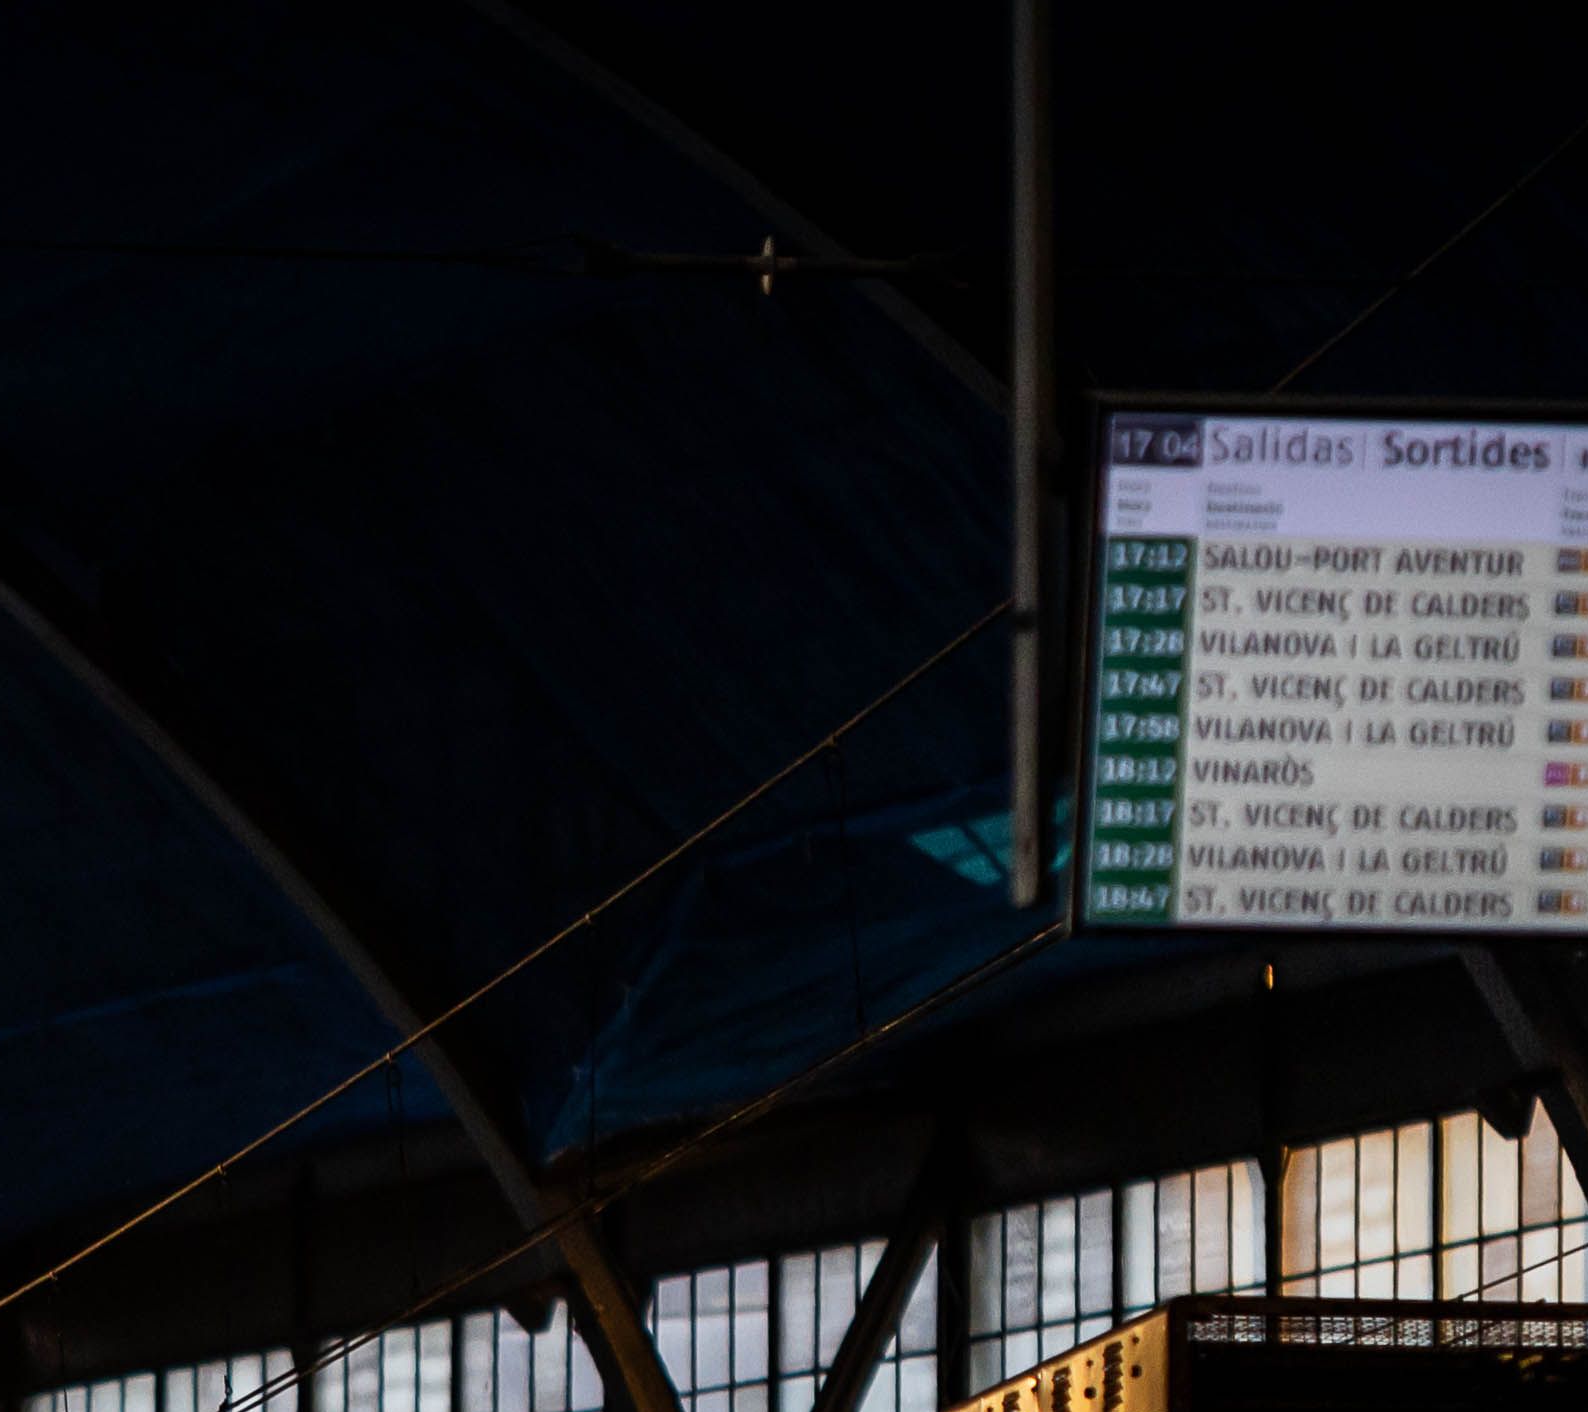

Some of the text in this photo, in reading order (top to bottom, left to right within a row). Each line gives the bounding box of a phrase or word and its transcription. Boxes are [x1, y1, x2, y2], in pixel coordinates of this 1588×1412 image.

[1211, 425, 1354, 465] Salidas
[1383, 429, 1551, 470] Sortides
[1205, 545, 1523, 576] SALOU-PORT AVENTUR
[1110, 585, 1186, 614] 17:17
[1203, 586, 1242, 614] ST.
[1257, 588, 1350, 621] VICENÇ
[1364, 590, 1395, 615] DE
[1412, 591, 1530, 622] CALDERS
[1200, 631, 1336, 658] VILANOVA
[1372, 635, 1401, 660] LA
[1415, 631, 1520, 664] GELTRÚ
[1198, 673, 1237, 701] ST.
[1253, 674, 1345, 710] VICENÇ
[1360, 677, 1391, 702] DE
[1408, 677, 1525, 706] CALDERS
[1196, 715, 1331, 744] VILANOVA
[1366, 721, 1395, 745] LA
[1409, 715, 1515, 748] GELTRÚ
[1193, 753, 1314, 787] VINARÒS
[1190, 803, 1230, 828] ST.
[1245, 804, 1337, 836] VICENÇ
[1353, 805, 1384, 830] DE
[1400, 805, 1518, 834] CALDERS
[1189, 845, 1325, 872] VILANOVA
[1359, 850, 1390, 874] LA
[1402, 844, 1508, 878] GELTRÚ
[1187, 887, 1226, 915] ST.
[1240, 888, 1332, 920] VICENÇ
[1348, 890, 1379, 915] DE
[1394, 891, 1513, 918] CALDERS
